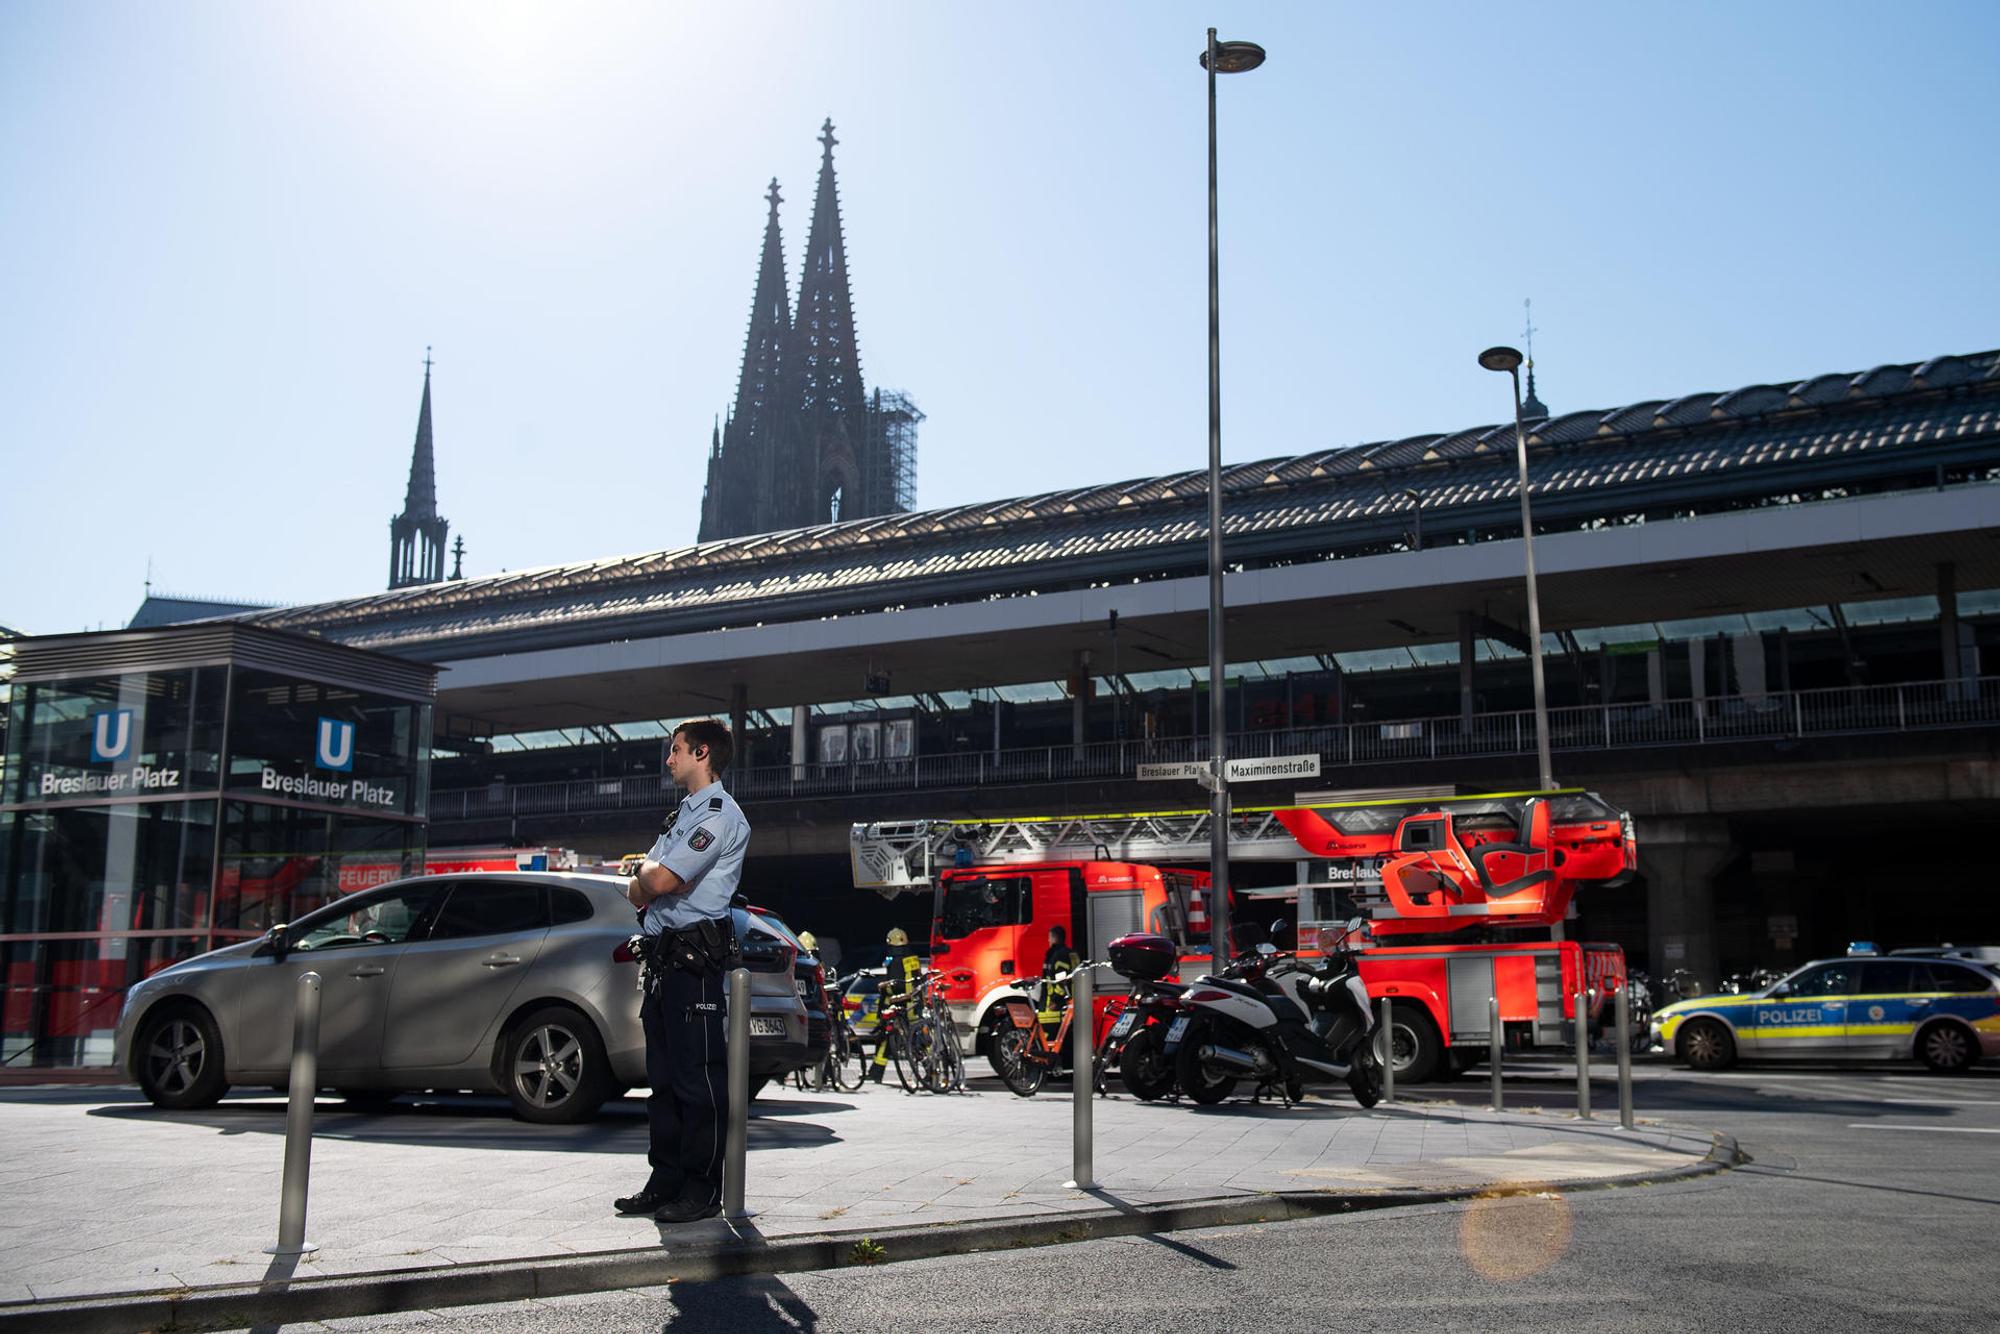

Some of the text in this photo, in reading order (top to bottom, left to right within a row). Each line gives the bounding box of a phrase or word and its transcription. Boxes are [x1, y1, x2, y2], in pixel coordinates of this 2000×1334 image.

[95, 711, 130, 759] U
[320, 720, 353, 767] U
[40, 766, 179, 795] Breslauer Platz
[1141, 763, 1205, 778] Breslauer Pla
[1230, 759, 1316, 778] Maximinenstraße
[261, 767, 395, 806] Breslauer Platz
[1759, 1008, 1823, 1024] POLIZEI
